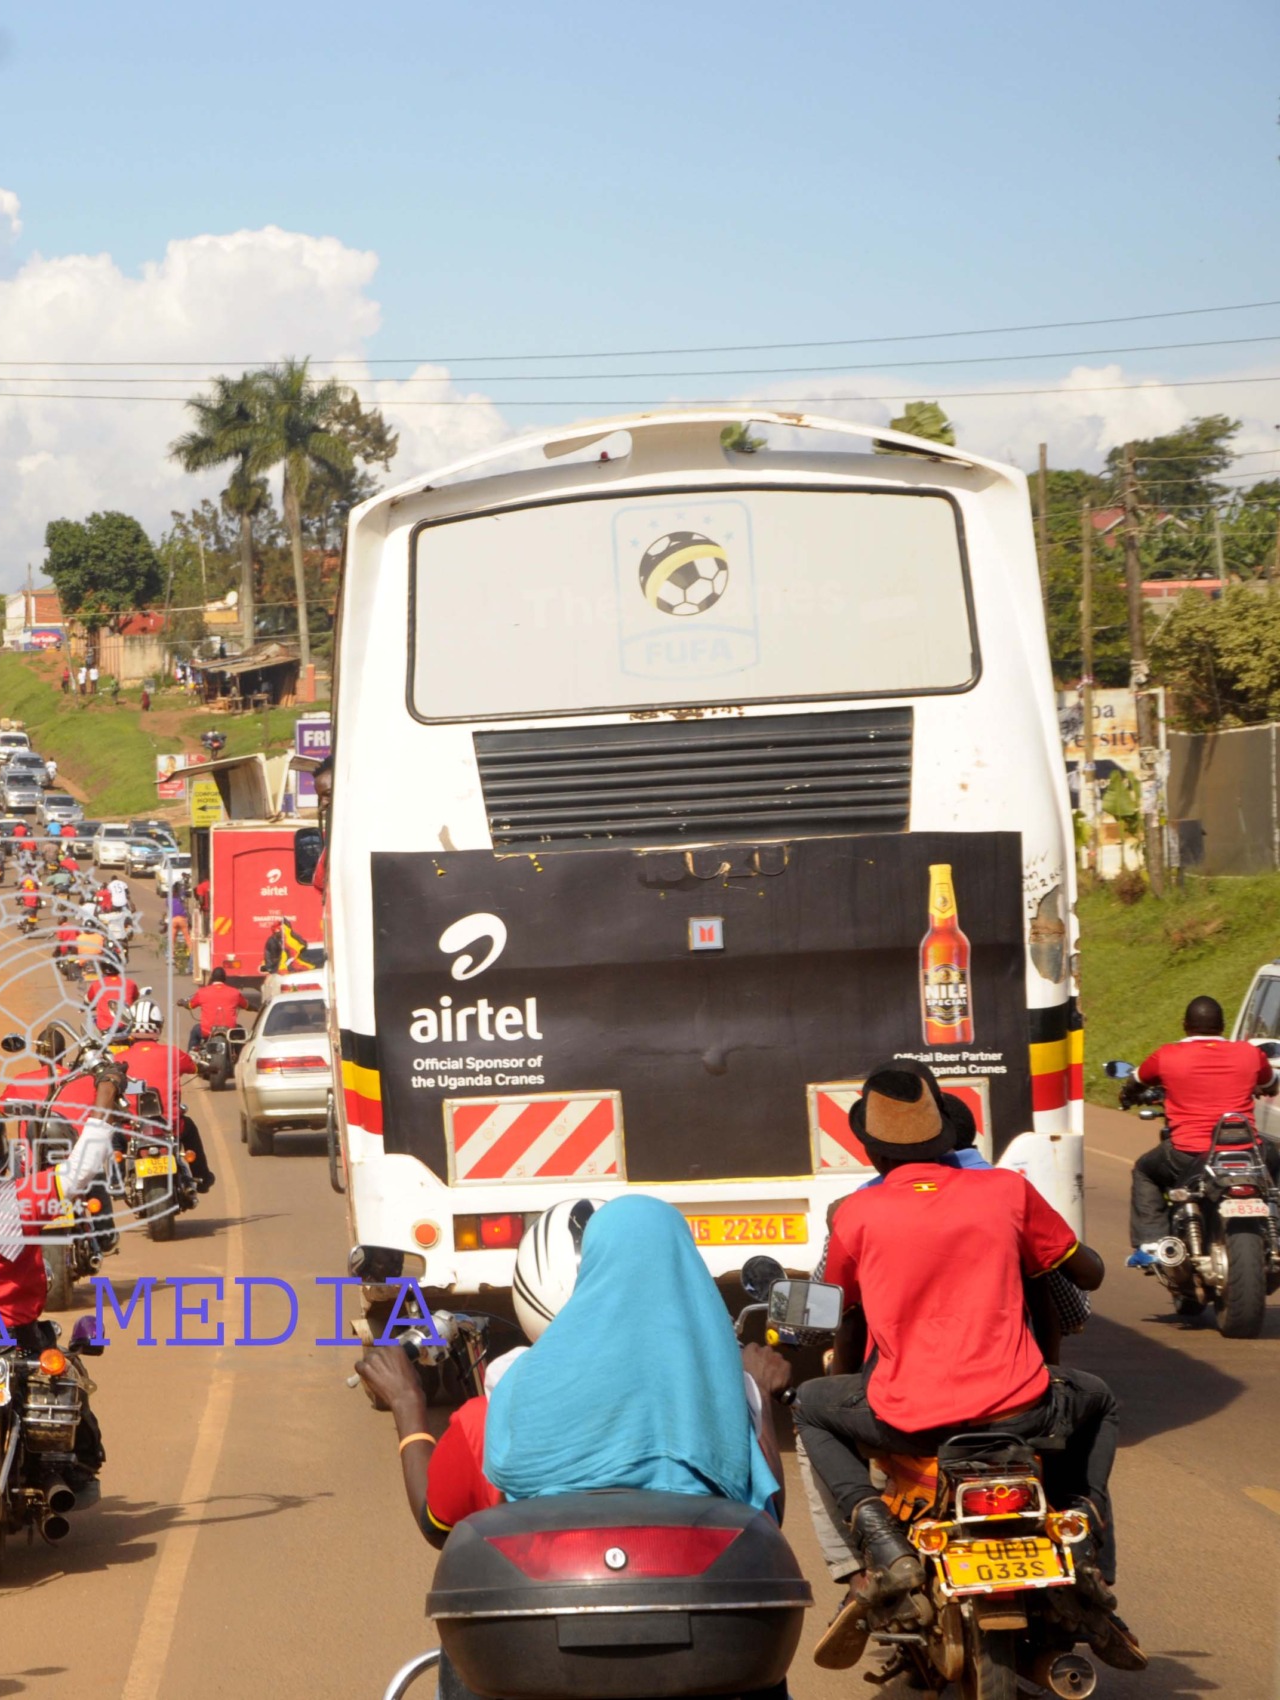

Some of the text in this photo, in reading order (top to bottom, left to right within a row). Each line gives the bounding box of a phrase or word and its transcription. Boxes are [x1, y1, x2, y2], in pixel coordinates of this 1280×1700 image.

[644, 637, 733, 665] FUFA
[260, 885, 289, 897] airtel
[924, 983, 967, 999] NILE
[926, 998, 967, 1007] SPECIAL
[409, 995, 544, 1044] airtel
[412, 1055, 544, 1072] Official Sponsor of
[935, 1052, 961, 1062] Beer
[962, 1051, 1003, 1062] Partner
[968, 1064, 1008, 1075] Cranes
[411, 1072, 546, 1090] the Uganda Cranes
